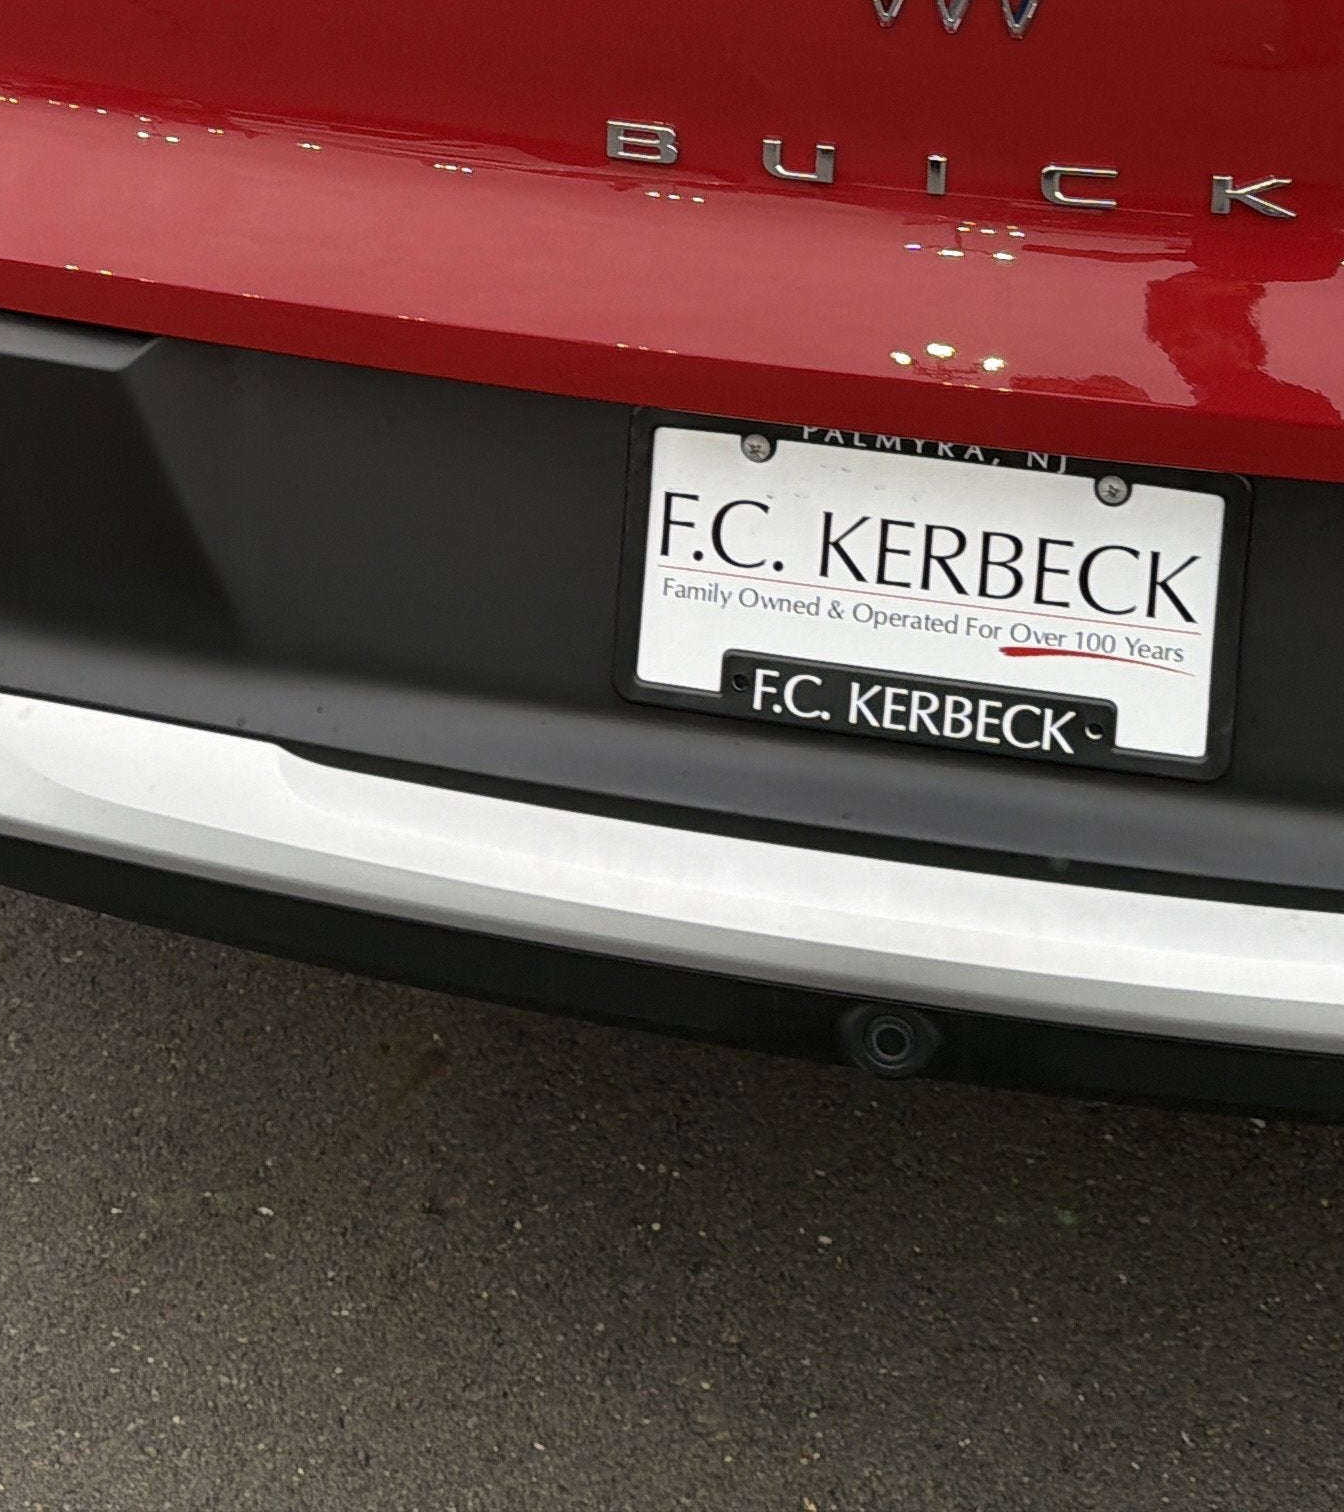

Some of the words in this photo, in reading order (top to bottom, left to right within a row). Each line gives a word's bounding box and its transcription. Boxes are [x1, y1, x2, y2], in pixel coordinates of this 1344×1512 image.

[606, 118, 1297, 218] BUICK
[802, 425, 1000, 466] PALMYRA,
[1026, 450, 1067, 474] NJ
[658, 490, 784, 573] F.C.
[818, 510, 1202, 624] KERBECK
[662, 577, 732, 609] Family
[738, 587, 820, 617] Owned
[827, 599, 845, 620] &
[852, 602, 959, 635] Operated
[965, 616, 1003, 640] For
[1009, 622, 1068, 649] Over
[1075, 631, 1117, 654] 100
[1124, 635, 1185, 664] Years
[752, 668, 831, 721] F.C.
[848, 681, 1077, 755] KERBECK
